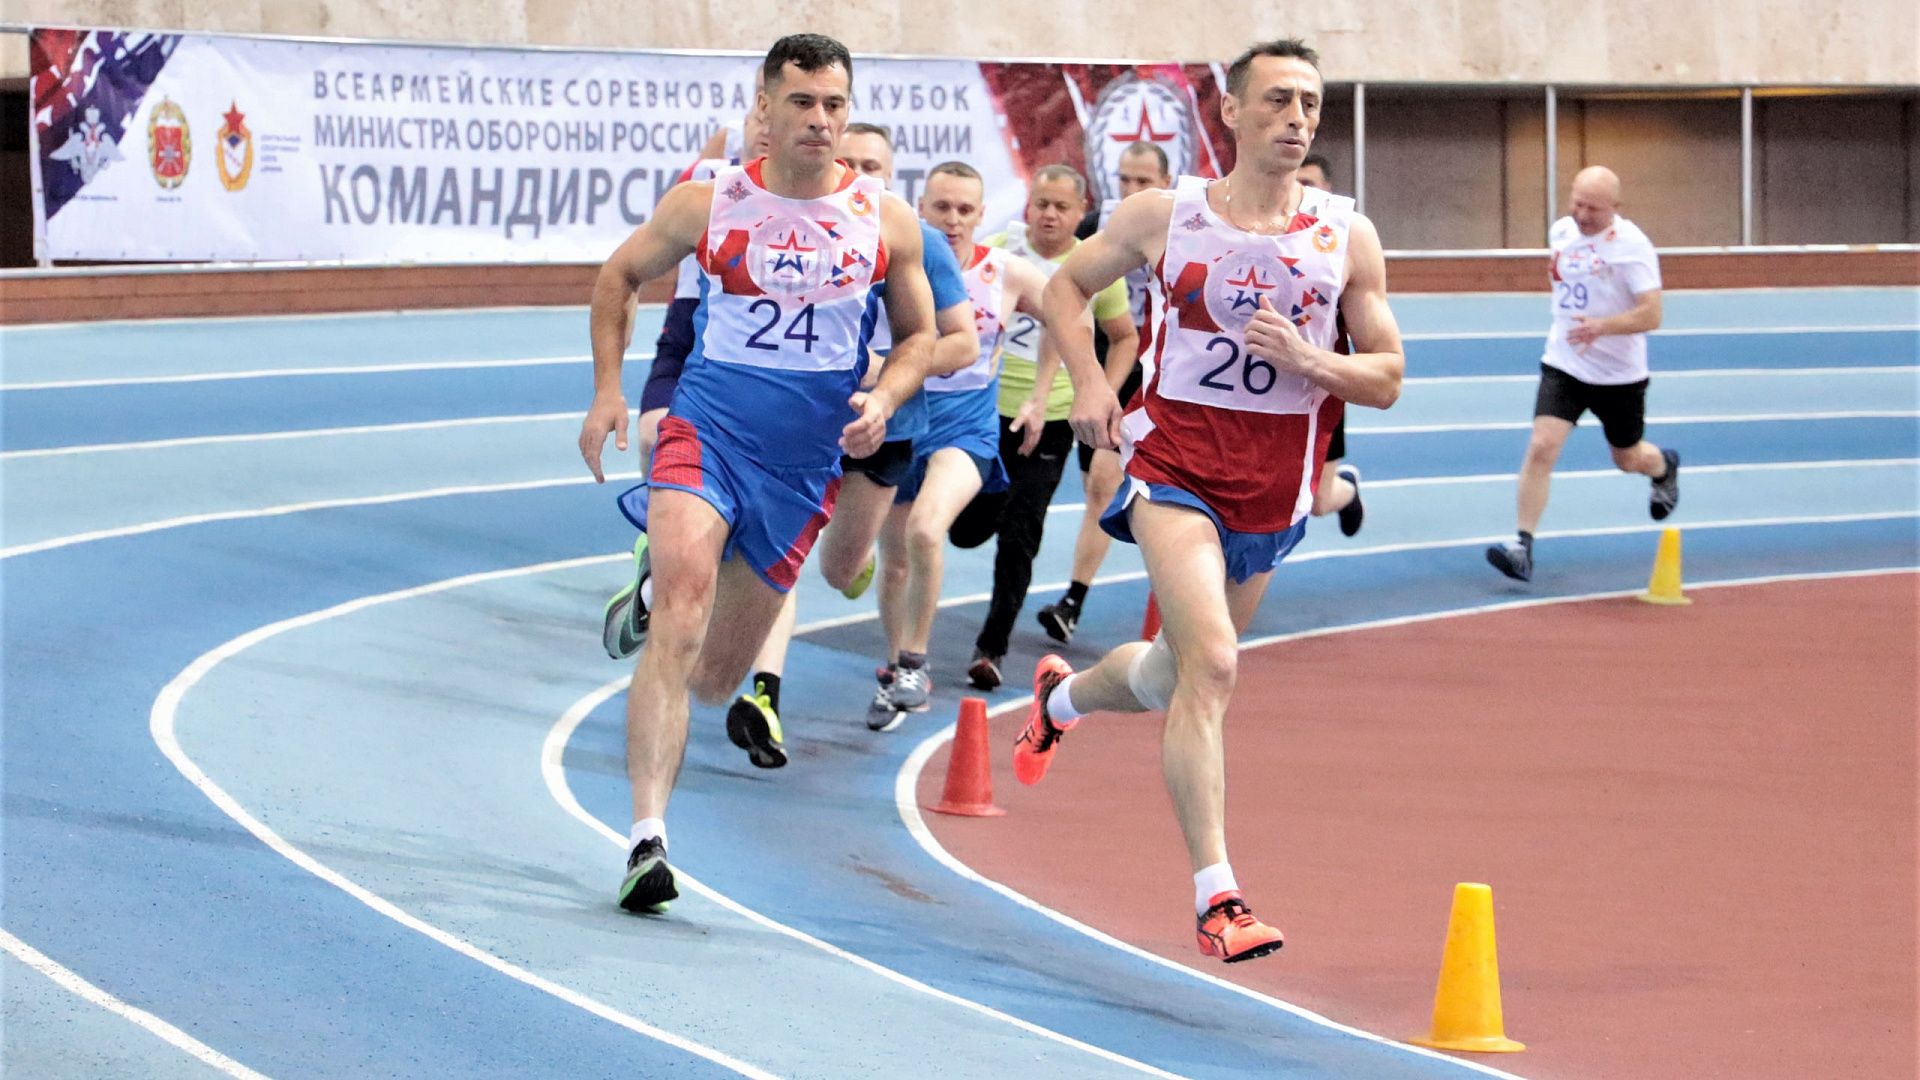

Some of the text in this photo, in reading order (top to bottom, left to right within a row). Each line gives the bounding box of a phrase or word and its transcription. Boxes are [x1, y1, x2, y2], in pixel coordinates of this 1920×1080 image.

[313, 69, 553, 107] ВСЕАРМЕЙСКИЕ
[564, 78, 747, 110] СОРЕВНОВА
[869, 83, 970, 112] КУБОК
[313, 114, 972, 160] МИНИСТРА ОБОРОНЫ РОССИЙ АЦИИ
[319, 163, 682, 239] КОМАНДИРСК
[1559, 281, 1589, 310] 29
[745, 298, 819, 353] 24
[1010, 316, 1036, 348] 2
[1199, 336, 1277, 395] 26
